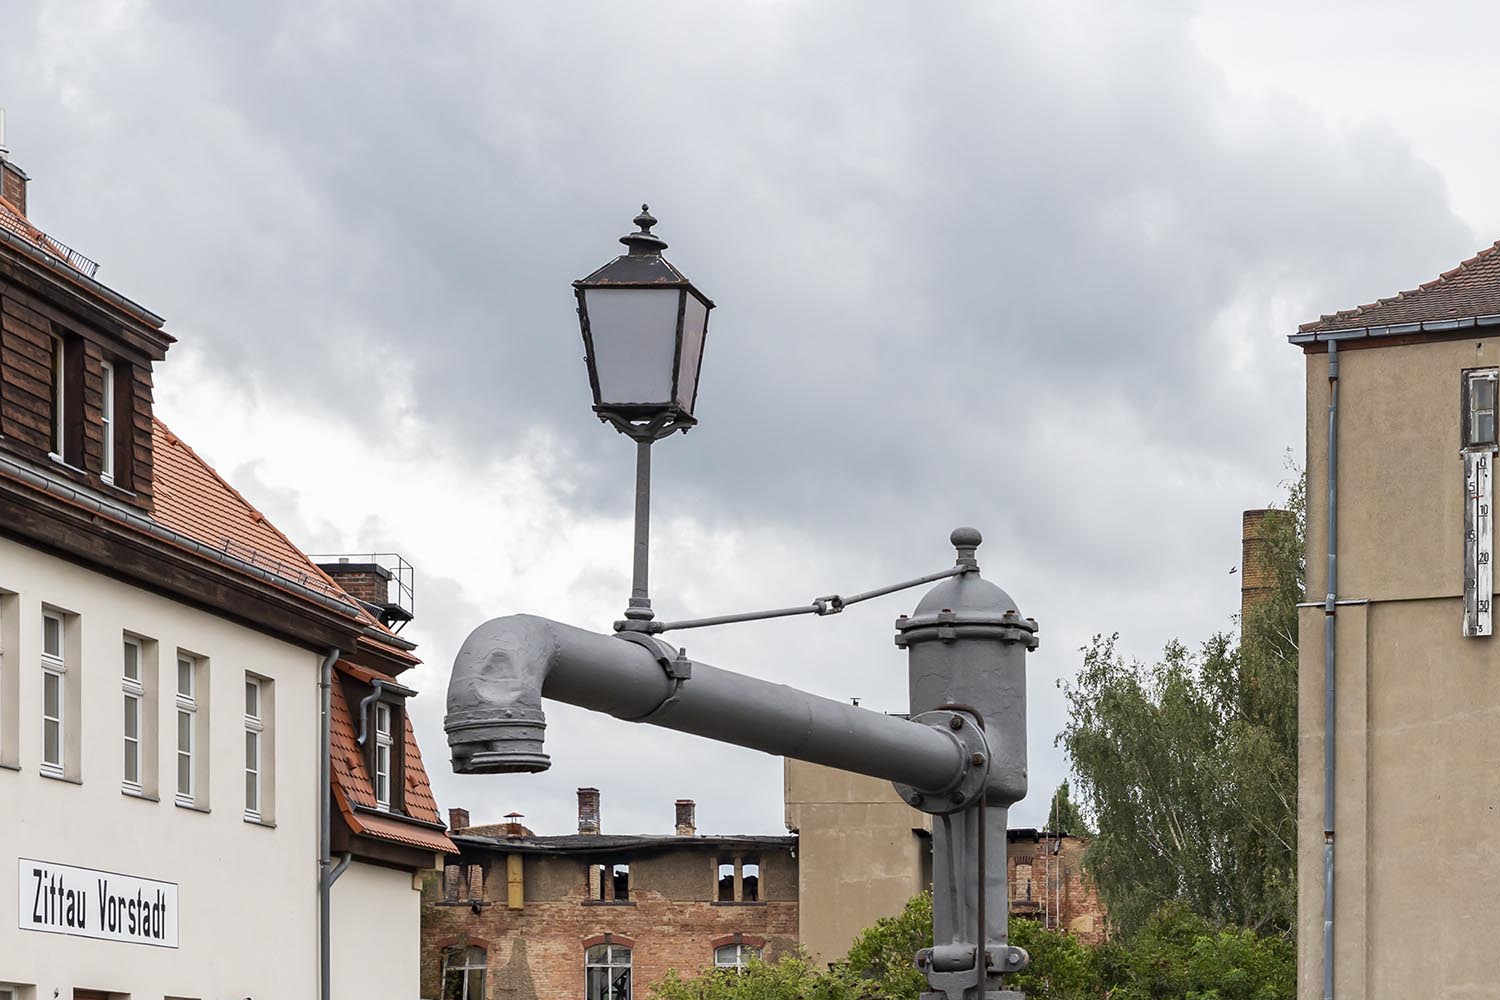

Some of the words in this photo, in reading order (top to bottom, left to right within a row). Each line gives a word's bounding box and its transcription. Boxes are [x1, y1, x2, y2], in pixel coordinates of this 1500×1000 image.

[1479, 456, 1487, 467] 0
[1468, 481, 1476, 493] 5
[1479, 504, 1489, 515] 10
[1479, 552, 1490, 563] 20
[1479, 600, 1490, 611] 30
[32, 868, 86, 929] Zittau
[97, 878, 166, 940] Vorstadt
